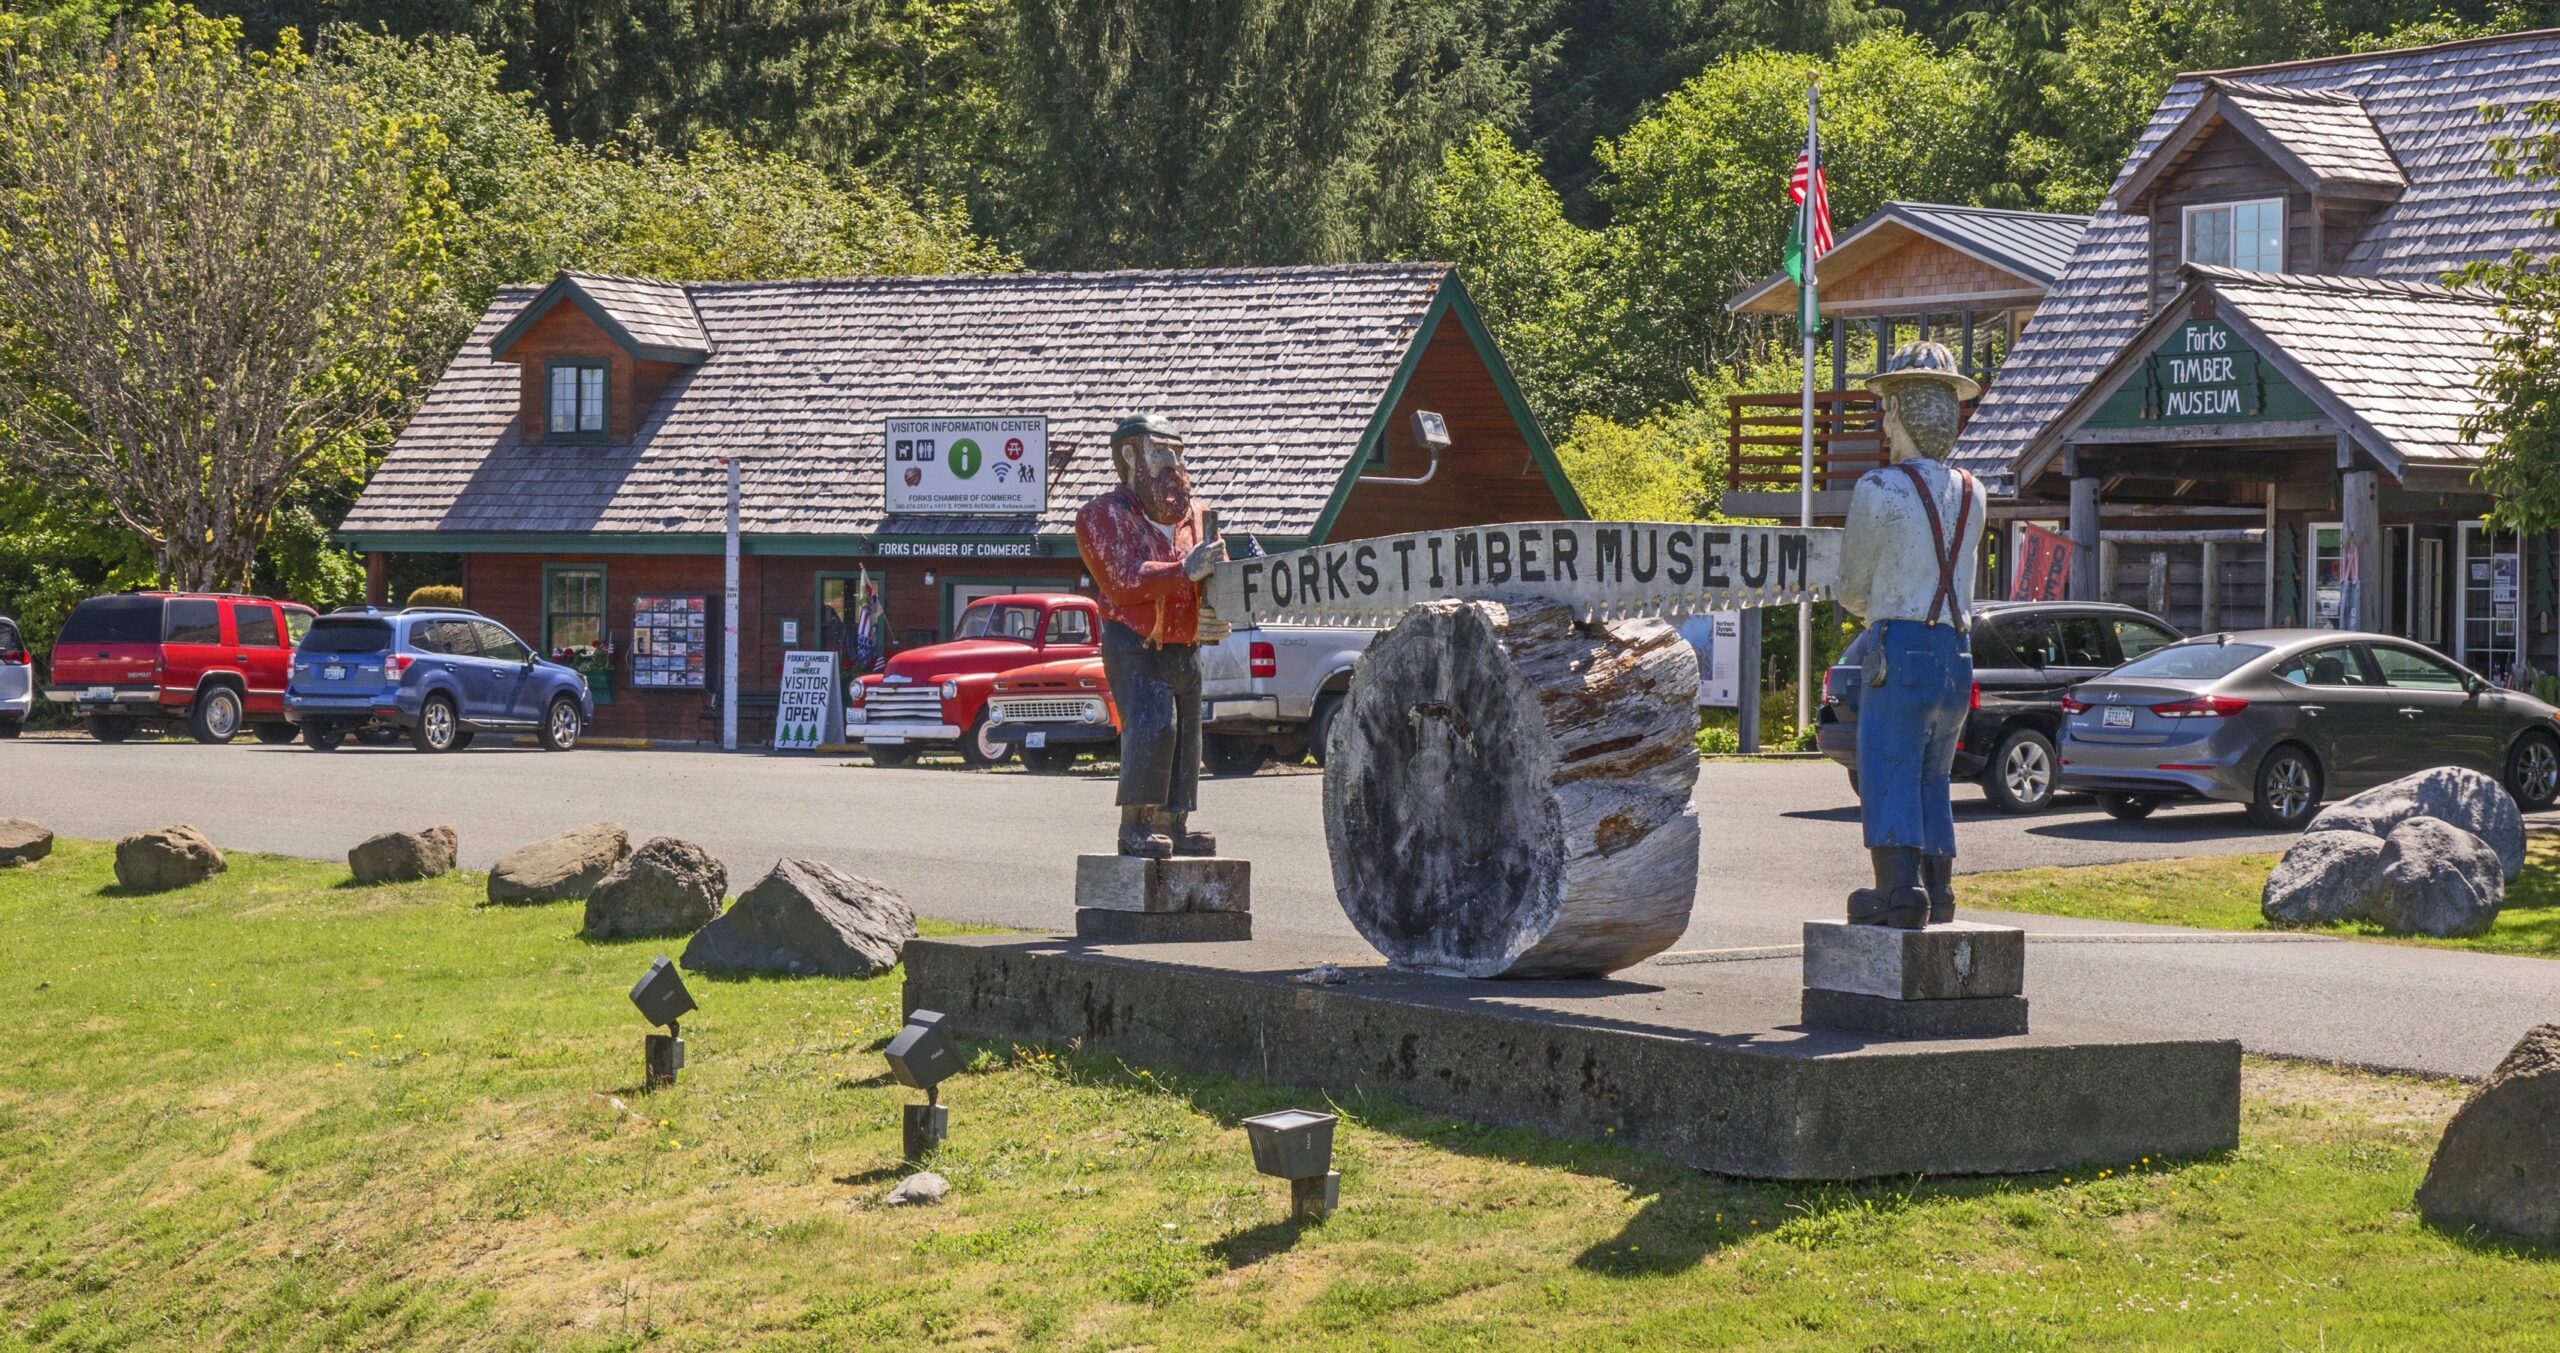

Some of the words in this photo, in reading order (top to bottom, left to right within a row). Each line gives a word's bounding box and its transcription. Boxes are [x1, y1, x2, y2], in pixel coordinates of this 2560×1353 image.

[2186, 325, 2227, 352] Forks
[2169, 357, 2236, 384] TIMBER
[2166, 389, 2241, 416] MUSEUM
[891, 422, 930, 433] VISITOR
[931, 421, 999, 432] INFORMATION
[1001, 420, 1041, 432] CENTER
[908, 494, 932, 502] FORKS
[934, 494, 968, 502] CHAMBER
[969, 494, 979, 502] OF
[981, 494, 1022, 502] COMMERCE
[878, 543, 910, 556] FORKS
[912, 543, 959, 556] CHAMBER
[961, 543, 974, 556] OF
[977, 543, 1031, 556] COMMERCE
[1242, 545, 1380, 613] FORKS
[1392, 528, 1579, 592] TIMBER
[1595, 528, 1808, 591] MUSEUM
[787, 654, 805, 663] FORKS
[805, 655, 830, 663] CHAMBER
[792, 667, 821, 675] COMMERCE
[784, 676, 829, 691] VISITOR
[782, 691, 827, 707] CENTER
[785, 706, 819, 722] OPEN
